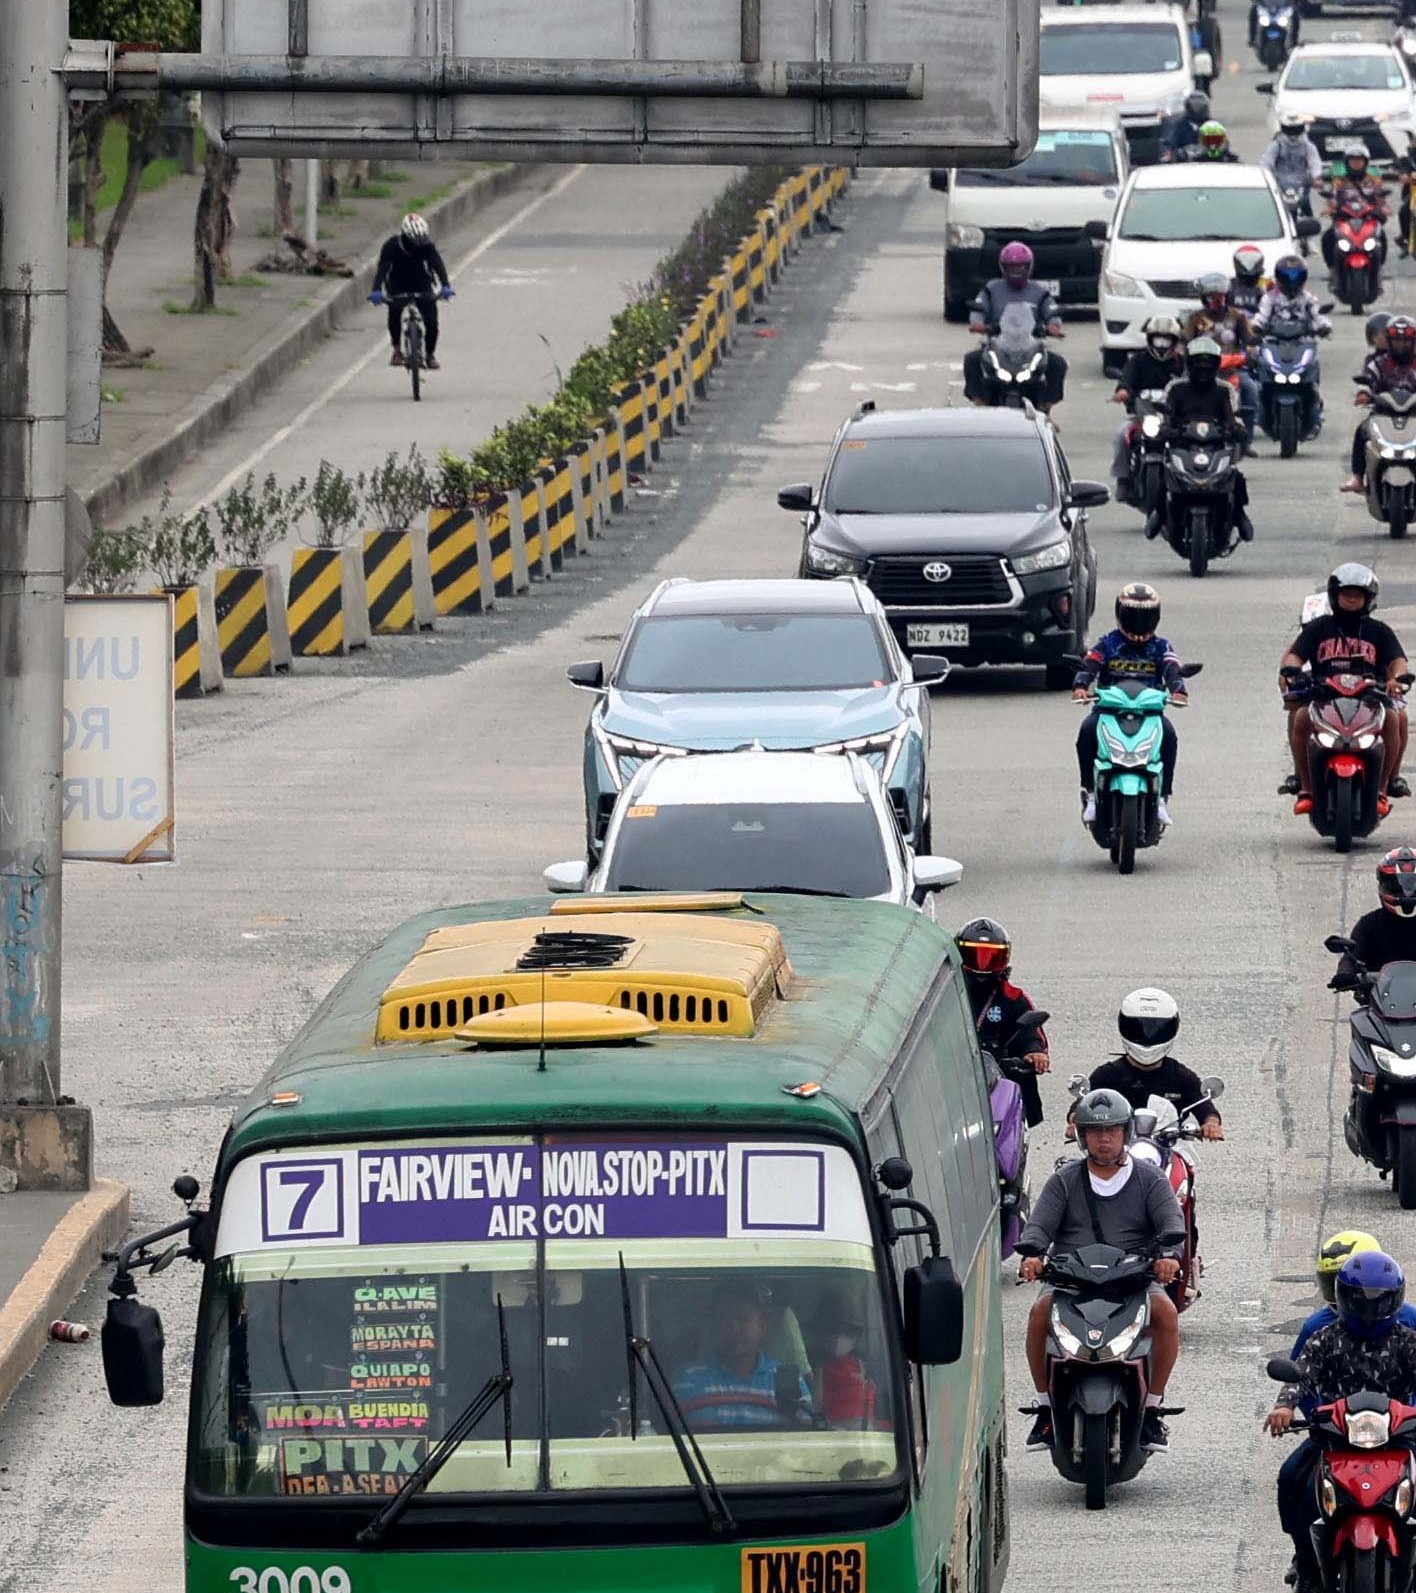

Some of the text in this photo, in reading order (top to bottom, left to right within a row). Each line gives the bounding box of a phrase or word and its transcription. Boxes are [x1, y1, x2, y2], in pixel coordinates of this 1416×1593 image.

[938, 629, 967, 642] 9422
[279, 1169, 325, 1231] 7
[487, 1203, 604, 1237] AIR CON
[354, 1300, 438, 1312] ILALIM
[352, 1325, 435, 1342] MORAYTA
[351, 1364, 431, 1378] QUIAPO
[351, 1376, 432, 1389] LAWTON
[266, 1404, 346, 1429] MOA
[349, 1403, 429, 1419] BUENDIA
[353, 1417, 427, 1429] TAFT
[284, 1438, 421, 1475] PITX
[229, 1565, 351, 1593] 3009
